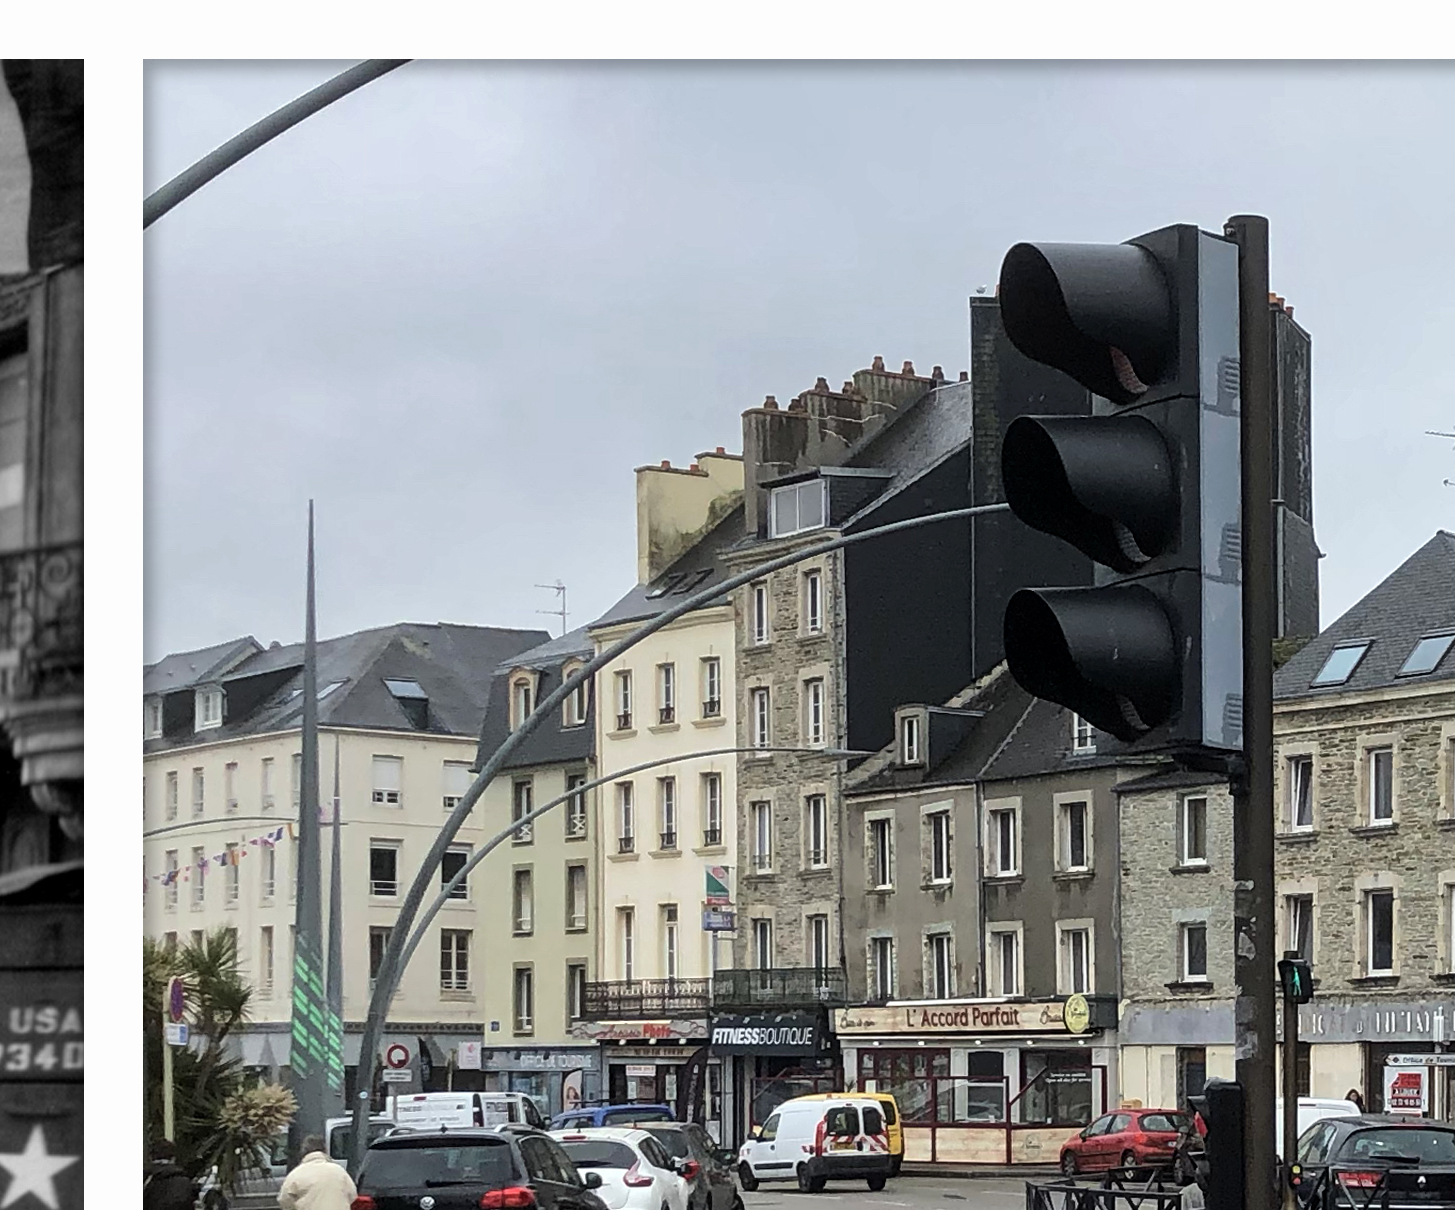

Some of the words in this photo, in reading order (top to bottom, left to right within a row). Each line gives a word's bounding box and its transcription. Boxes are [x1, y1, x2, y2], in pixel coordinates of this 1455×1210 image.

[9, 1008, 84, 1034] USA
[921, 1007, 969, 1027] Accord
[972, 1006, 1020, 1027] Parfait
